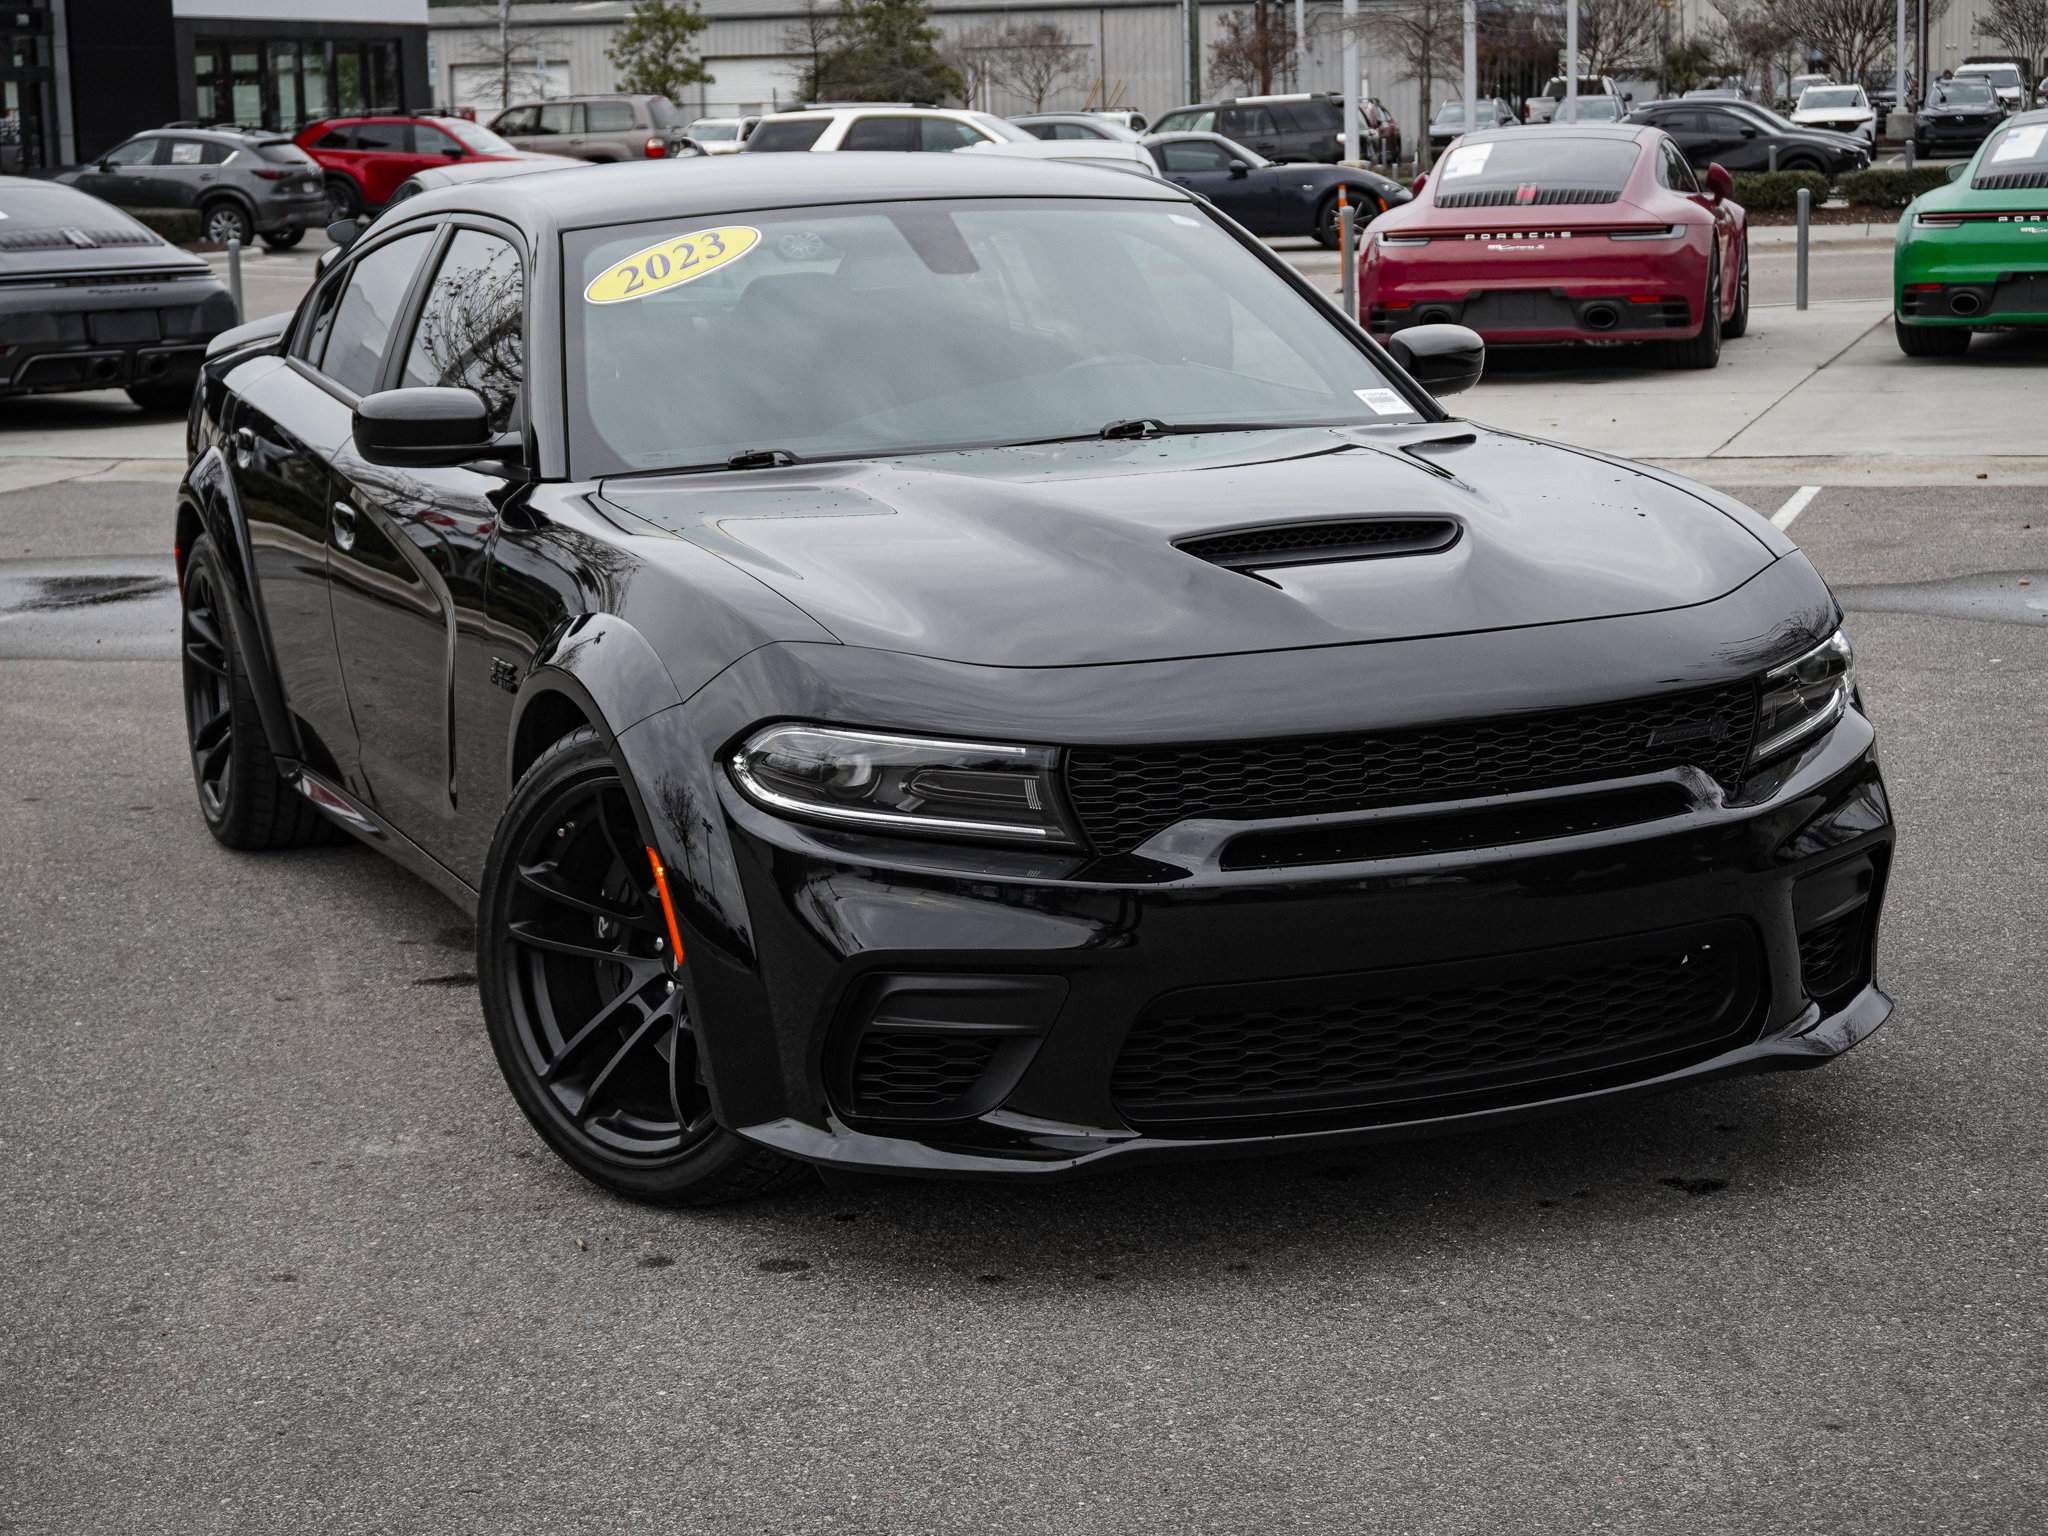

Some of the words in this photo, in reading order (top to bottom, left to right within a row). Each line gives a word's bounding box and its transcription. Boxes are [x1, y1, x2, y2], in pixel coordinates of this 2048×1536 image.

[1998, 215, 2048, 223] POR
[1464, 231, 1571, 241] PORSCHE
[617, 232, 726, 294] 2023
